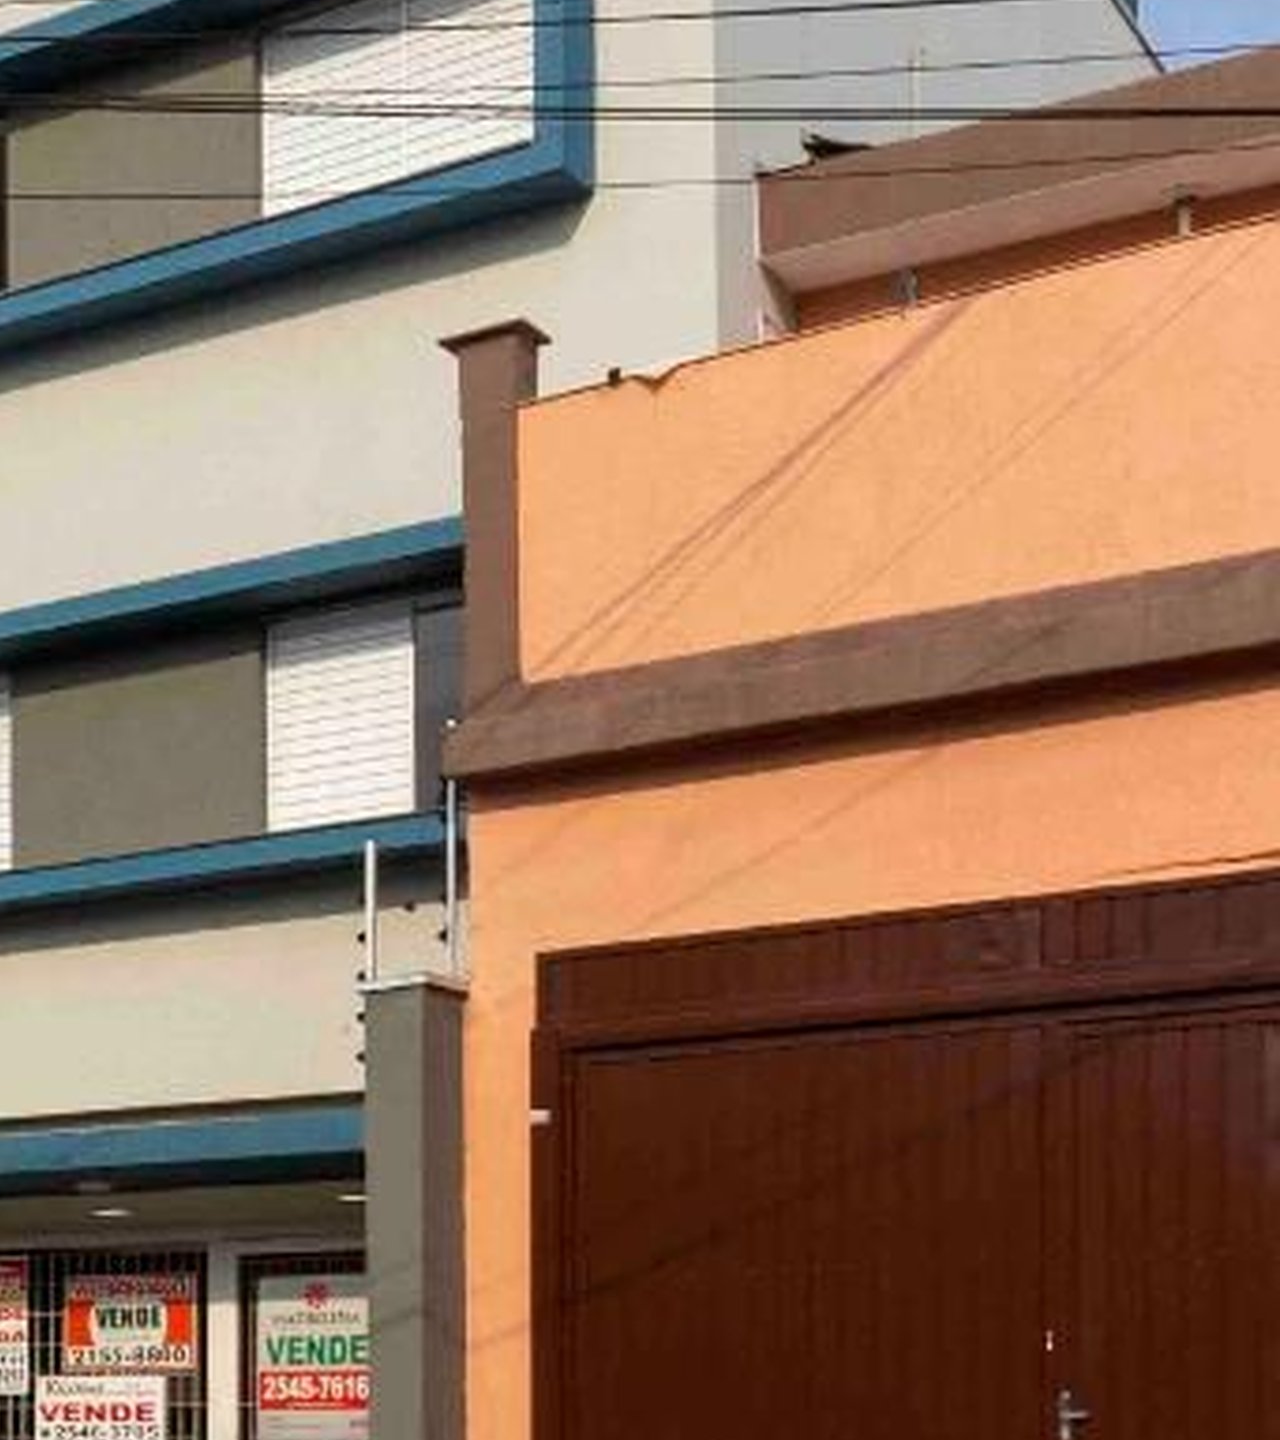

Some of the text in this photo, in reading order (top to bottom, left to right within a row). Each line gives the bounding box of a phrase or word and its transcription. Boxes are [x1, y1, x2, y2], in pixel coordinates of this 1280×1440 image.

[96, 1305, 161, 1329] VENDE
[266, 1333, 371, 1365] VENDE
[262, 1374, 370, 1401] 2545-7616
[39, 1401, 156, 1422] VENDE
